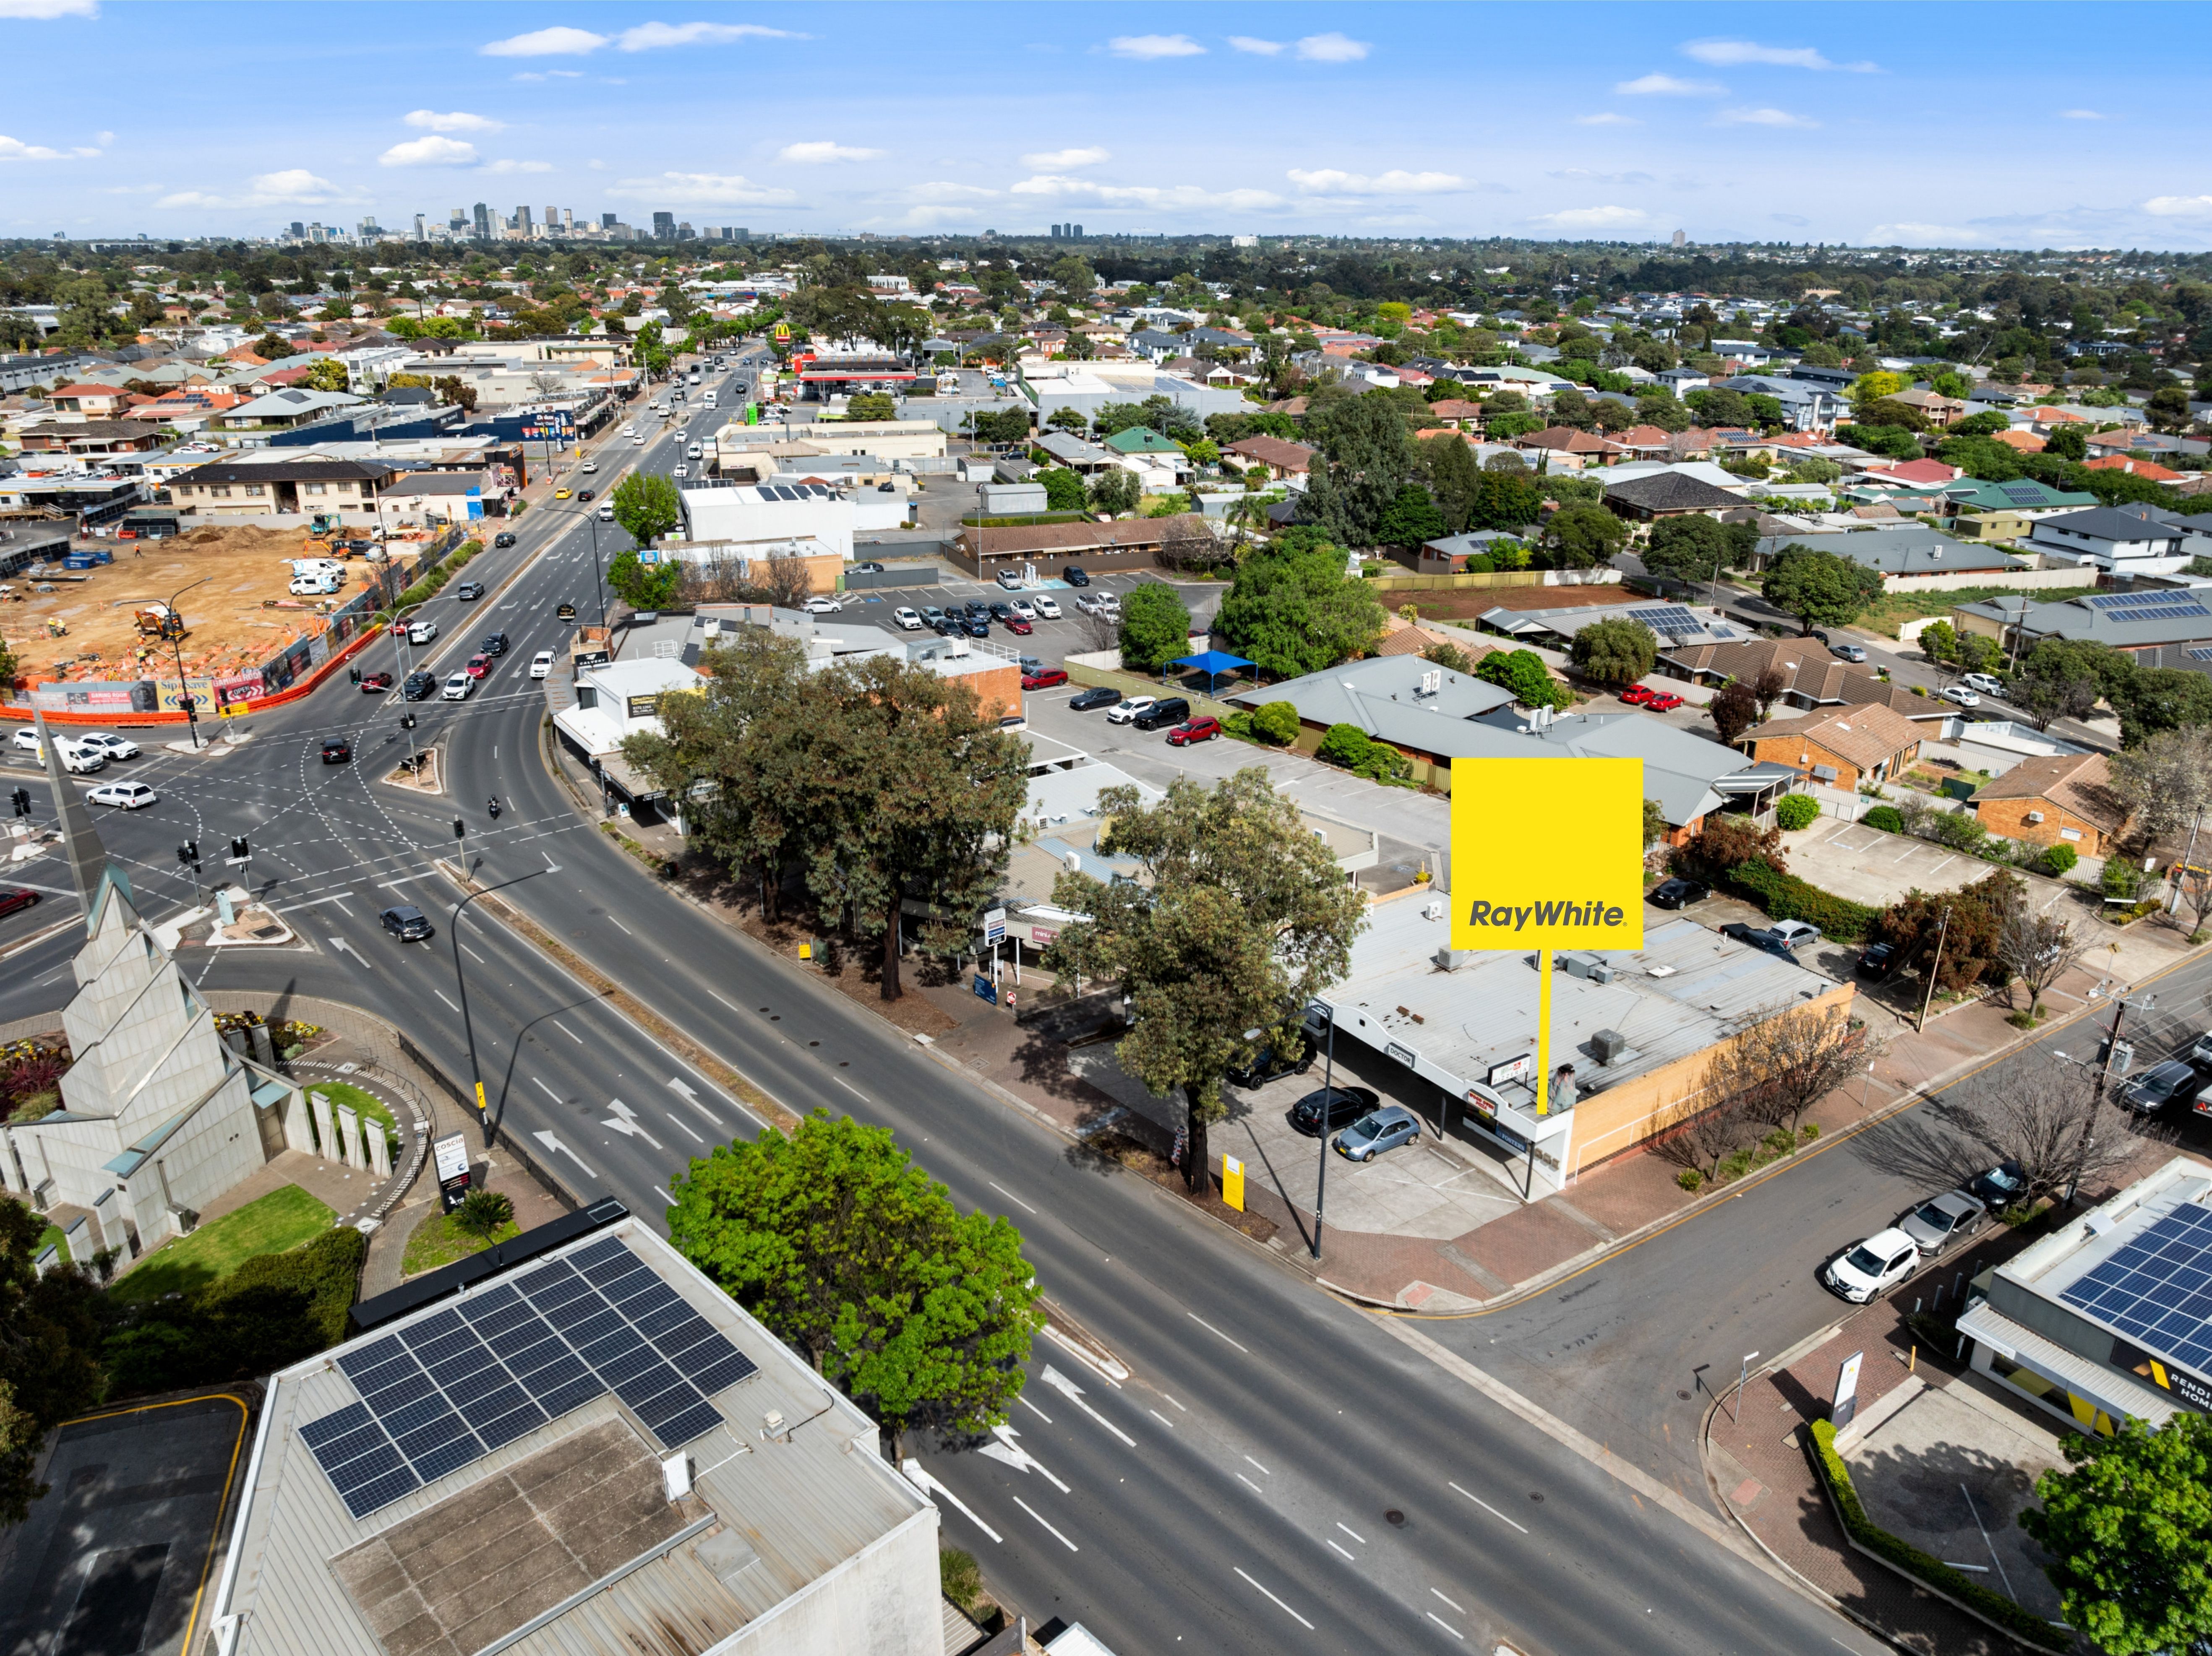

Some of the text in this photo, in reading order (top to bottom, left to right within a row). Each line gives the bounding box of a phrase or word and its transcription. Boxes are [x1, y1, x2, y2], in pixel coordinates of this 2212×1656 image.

[162, 681, 175, 691] Sip
[213, 675, 242, 687] GAMING
[234, 685, 250, 695] OPEN
[1390, 1048, 1411, 1064] DOCTOR
[1494, 1068, 1527, 1082] PIZZERIA
[1469, 1092, 1482, 1102] WOOD
[1476, 1101, 1487, 1110] PIZZA
[436, 1137, 464, 1151] coscia
[2170, 1373, 2212, 1398] RENDI
